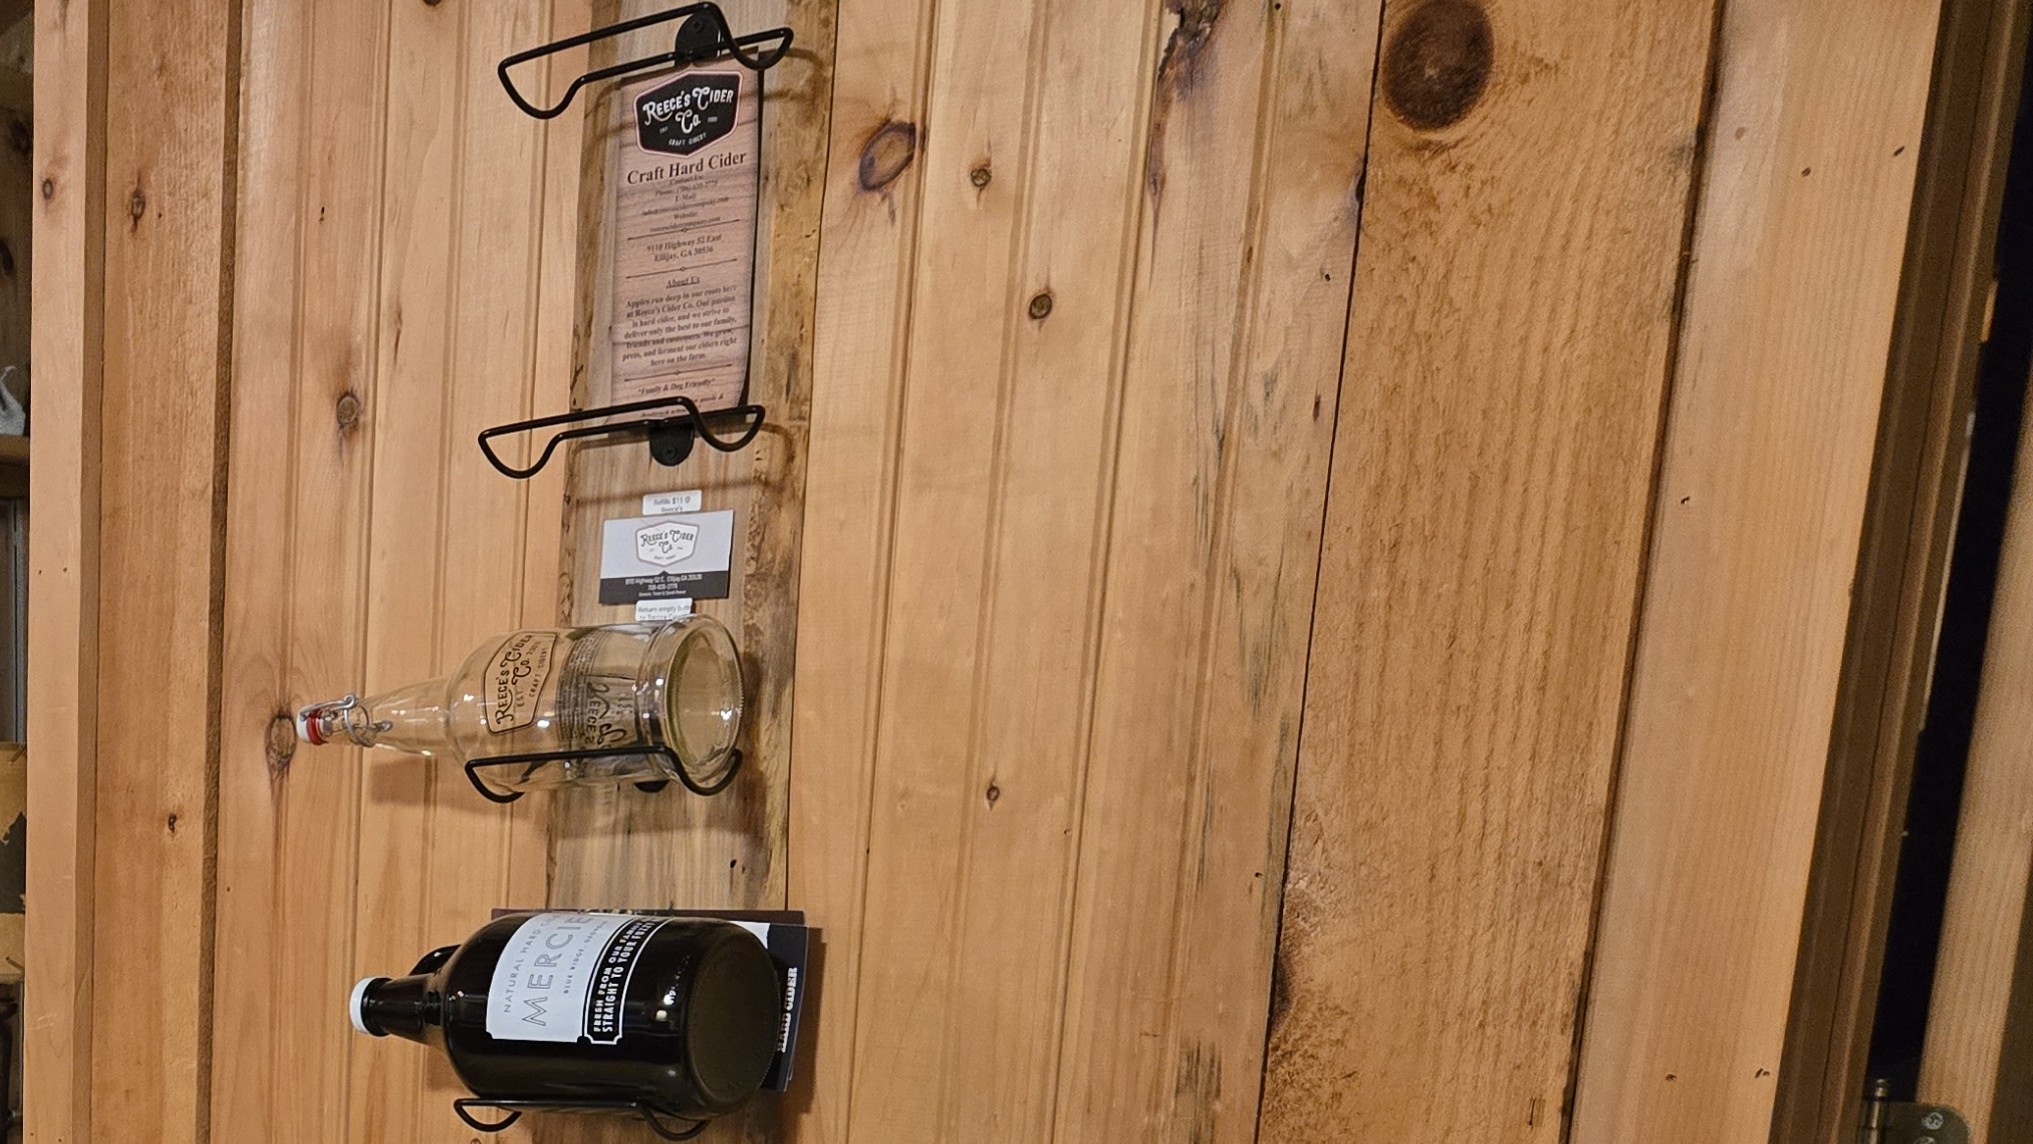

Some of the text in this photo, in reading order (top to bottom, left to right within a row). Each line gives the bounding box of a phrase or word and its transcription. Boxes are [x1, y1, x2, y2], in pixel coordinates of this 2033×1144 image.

[642, 86, 734, 125] REECE'S CIDER
[627, 152, 747, 185] Craft Hard Cider
[706, 233, 722, 242] East
[680, 249, 692, 257] GA
[666, 278, 689, 288] About
[626, 299, 650, 309] Apples
[665, 294, 682, 303] deep
[635, 306, 660, 317] Reece's
[661, 303, 681, 313] Cider
[696, 299, 710, 308] Our
[711, 295, 736, 306] passion
[640, 317, 655, 327] hard
[677, 313, 691, 321] and
[702, 307, 721, 317] strive
[624, 330, 647, 339] deliver
[649, 326, 664, 336] only
[665, 325, 676, 333] the
[677, 323, 691, 332] best
[652, 337, 665, 345] and
[643, 349, 656, 357] and
[657, 345, 684, 355] ferment
[685, 343, 698, 351] our
[698, 340, 719, 349] ciders
[720, 337, 737, 347] right
[651, 358, 665, 366] here
[670, 382, 683, 391] Dog
[494, 634, 533, 725] REECE'S CIDER
[608, 945, 623, 964] OUR
[617, 941, 637, 963] YOUR
[504, 929, 541, 1013] NATURAL HARD
[611, 966, 624, 979] TO
[563, 974, 573, 994] BLUE
[598, 967, 612, 996] FROM
[784, 967, 798, 1011] CIDER
[593, 999, 604, 1033] FRESH
[602, 982, 619, 1033] STRAIGHT
